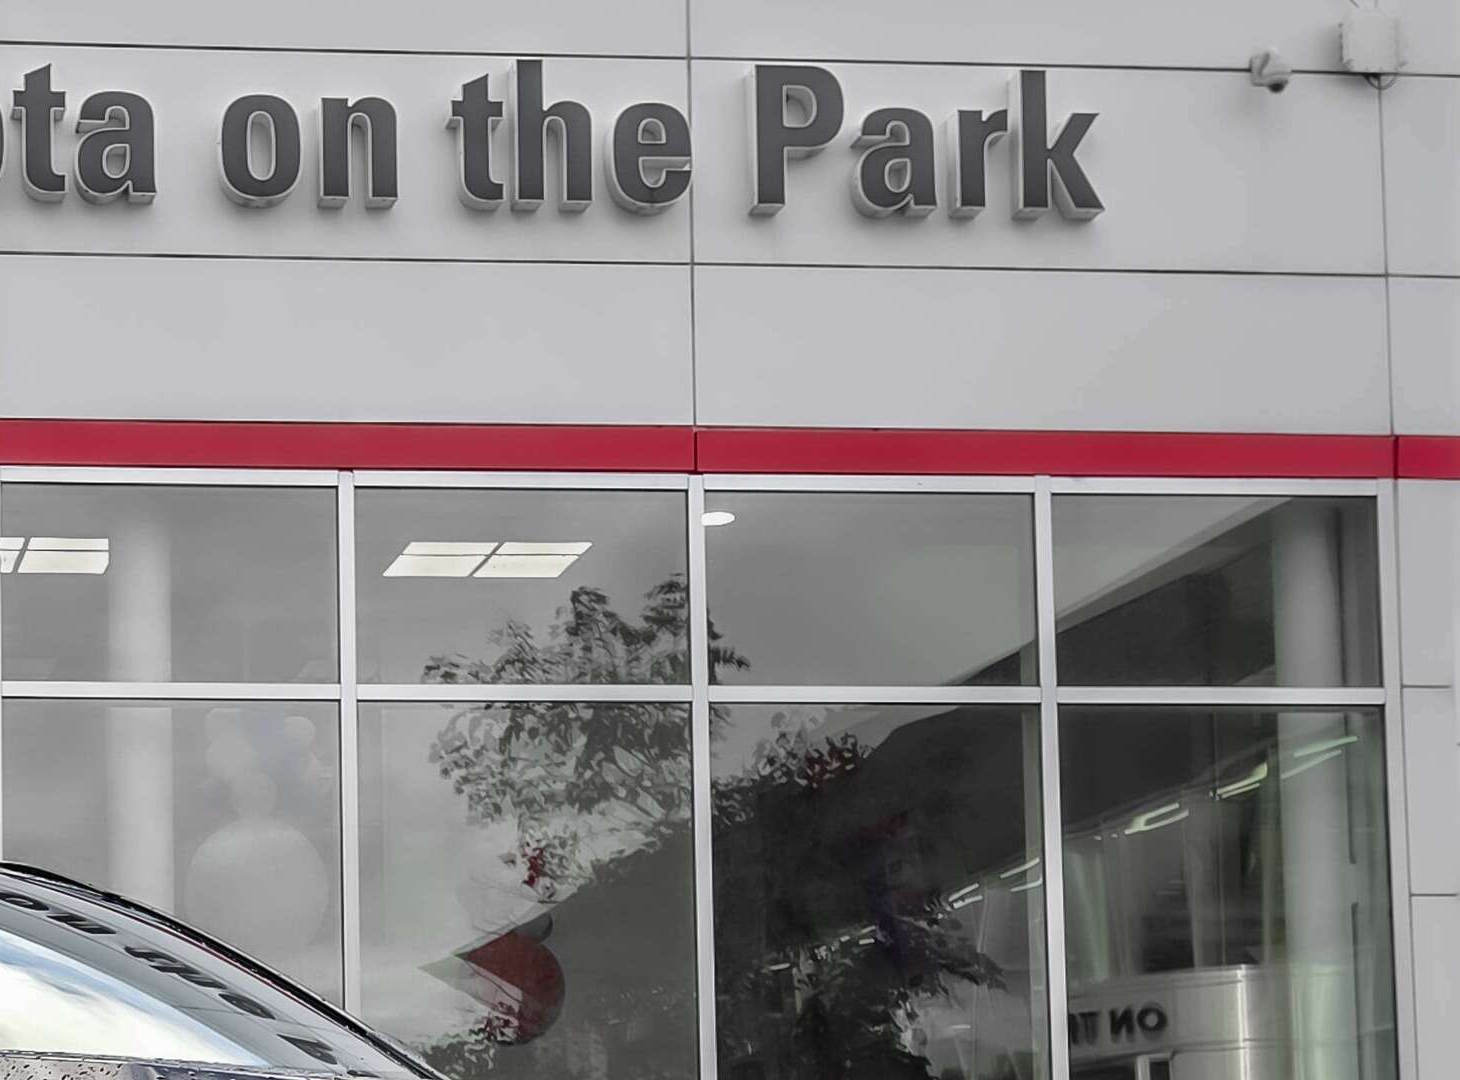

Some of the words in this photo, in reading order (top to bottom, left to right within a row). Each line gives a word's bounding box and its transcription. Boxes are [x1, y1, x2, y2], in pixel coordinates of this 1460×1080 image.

[218, 94, 399, 211] on
[445, 59, 692, 215] the
[745, 64, 1106, 221] Park
